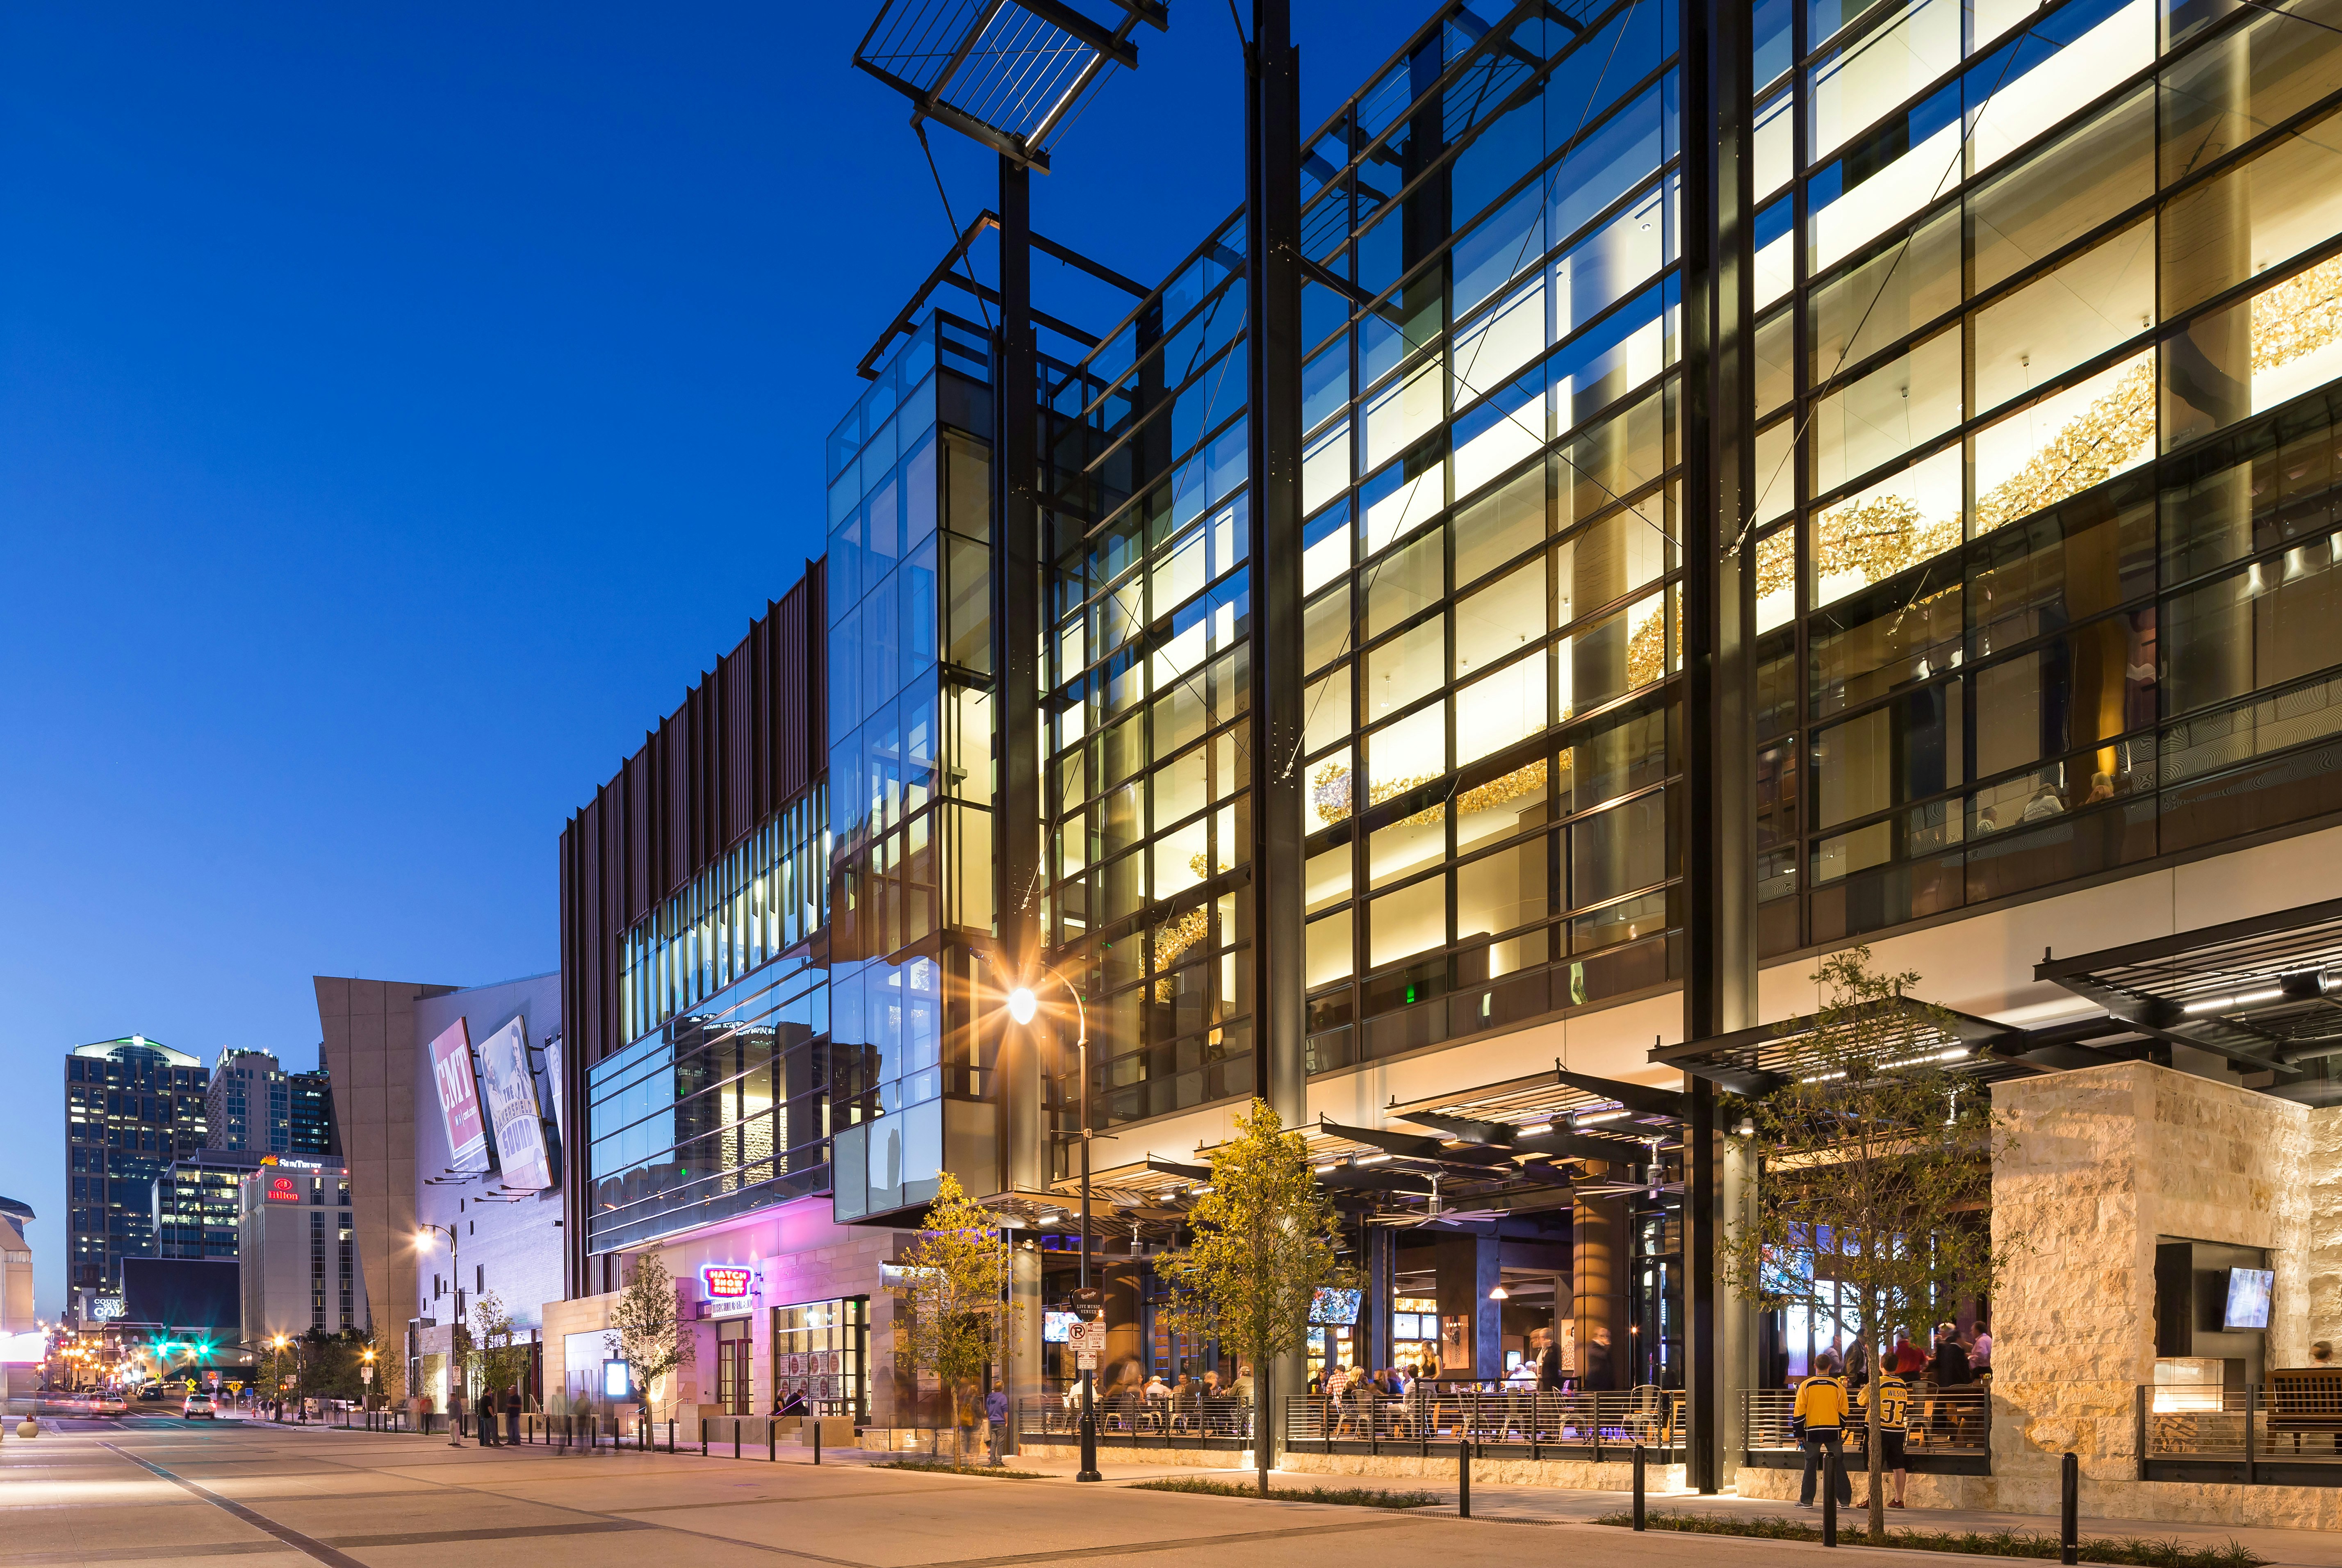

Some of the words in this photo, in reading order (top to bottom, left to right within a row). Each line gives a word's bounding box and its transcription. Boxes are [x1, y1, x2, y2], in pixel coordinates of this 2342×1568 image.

[436, 1043, 471, 1112] CMT
[503, 1084, 514, 1103] THE
[463, 1105, 477, 1120] cmt.com
[495, 1100, 532, 1133] BAKERSFIELD
[502, 1119, 533, 1158] SOUND
[268, 1191, 299, 1200] Hilton
[710, 1271, 747, 1279] HATCH
[1880, 1399, 1907, 1426] 33
